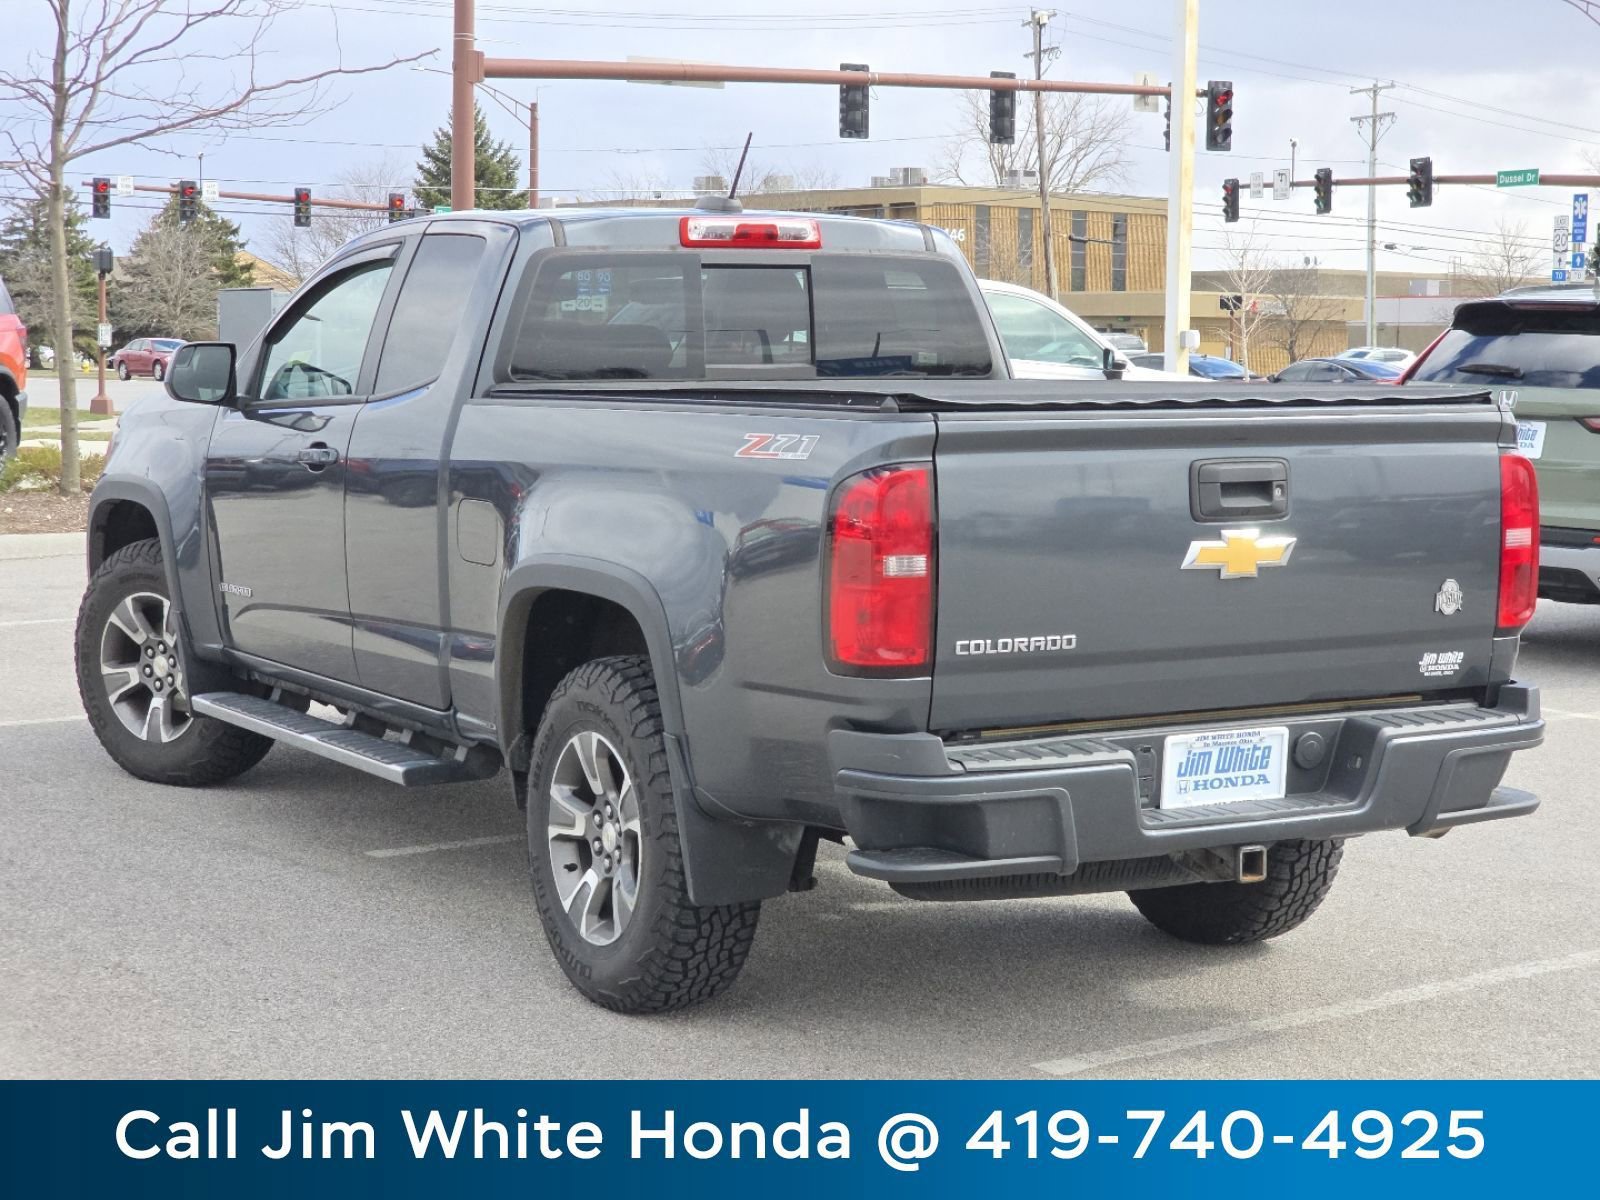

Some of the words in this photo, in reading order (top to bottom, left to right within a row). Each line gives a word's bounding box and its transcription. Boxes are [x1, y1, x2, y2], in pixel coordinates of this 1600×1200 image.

[1499, 173, 1524, 184] Dussel
[1527, 172, 1536, 182] Dr
[1554, 232, 1567, 247] 20
[577, 271, 591, 281] 80
[734, 432, 820, 460] Z71
[955, 634, 1077, 655] COLORADO
[1177, 750, 1212, 778] Jim
[1215, 744, 1272, 774] White
[1192, 774, 1270, 791] HONDA
